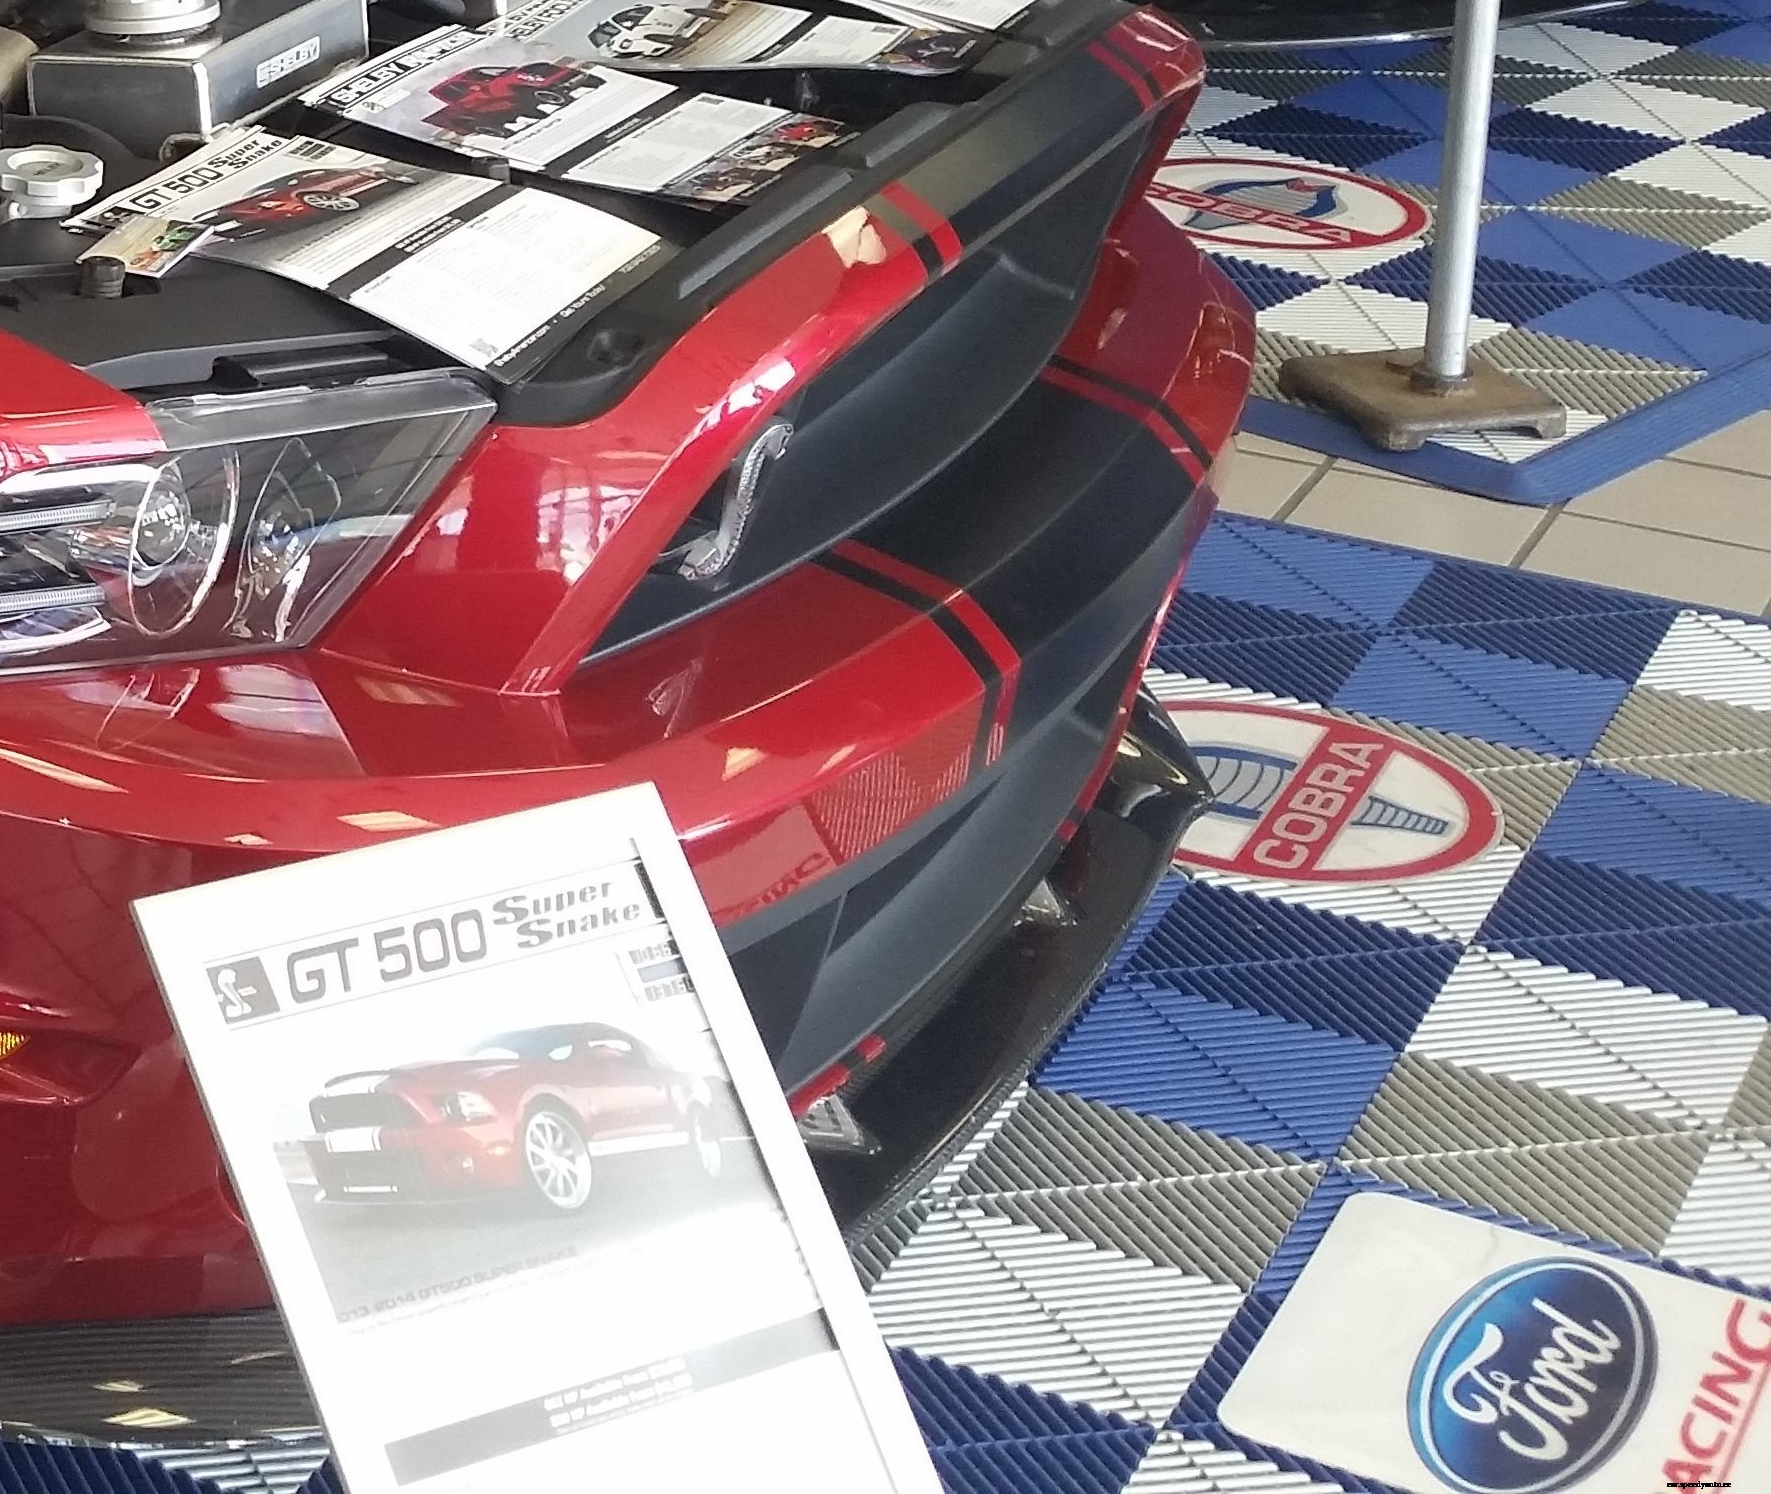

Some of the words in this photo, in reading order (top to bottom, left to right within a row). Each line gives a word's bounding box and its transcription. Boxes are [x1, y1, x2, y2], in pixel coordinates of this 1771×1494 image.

[331, 60, 405, 103] SHELBY
[129, 183, 173, 210] GT
[166, 166, 224, 196] 500
[208, 138, 262, 168] Super
[233, 138, 284, 170] Snake
[1252, 742, 1385, 869] COBRA
[286, 937, 360, 1004] GT
[373, 908, 488, 983] 500
[492, 881, 614, 926] Super
[516, 903, 641, 950] Snake
[1442, 1296, 1622, 1461] Ford
